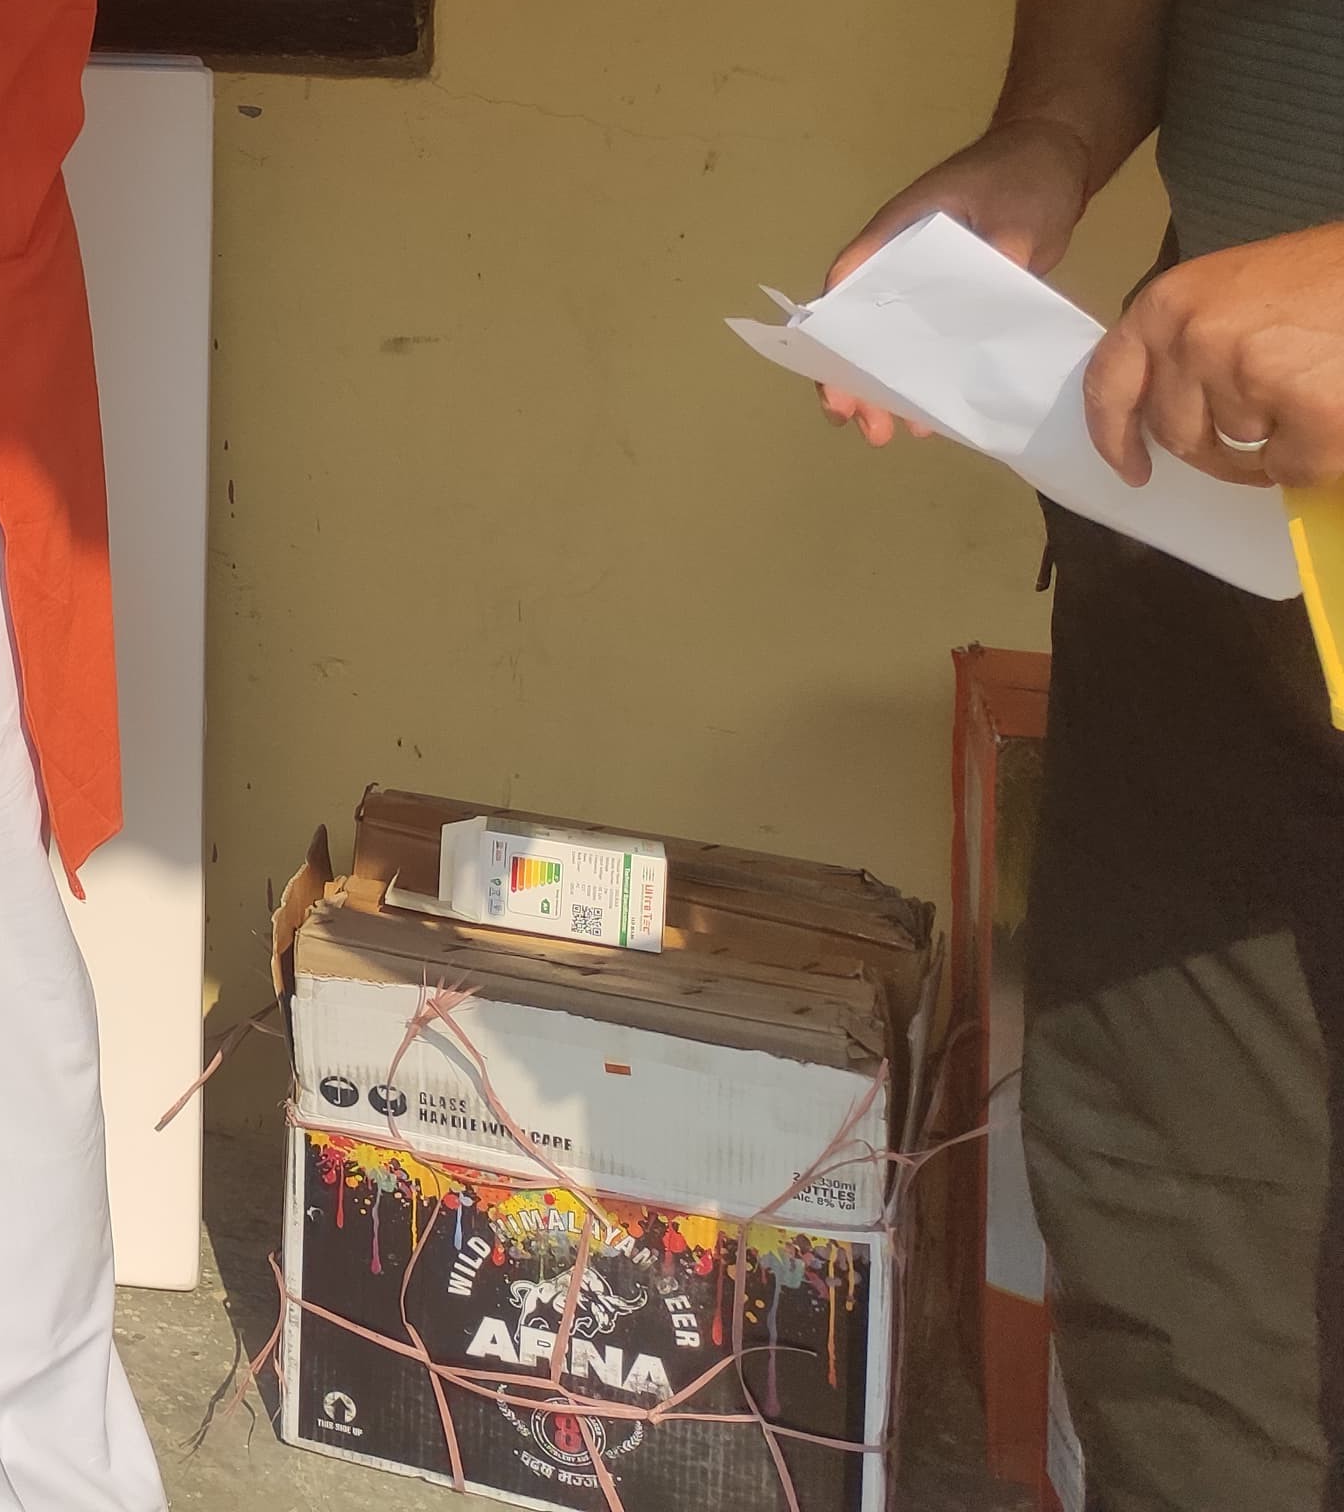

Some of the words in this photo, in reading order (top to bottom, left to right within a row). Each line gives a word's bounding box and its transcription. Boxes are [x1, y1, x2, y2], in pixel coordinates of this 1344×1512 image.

[419, 1091, 467, 1114] GLASS
[419, 1107, 477, 1132] HANDLE
[530, 1131, 573, 1151] CARE
[794, 1182, 856, 1203] OTTLES
[816, 1197, 835, 1209] 8%
[838, 1201, 856, 1211] Vol
[448, 1235, 492, 1296] WILD
[488, 1208, 658, 1269] HIMALAYAN
[657, 1275, 701, 1349] BEER
[465, 1316, 675, 1402] ARNA
